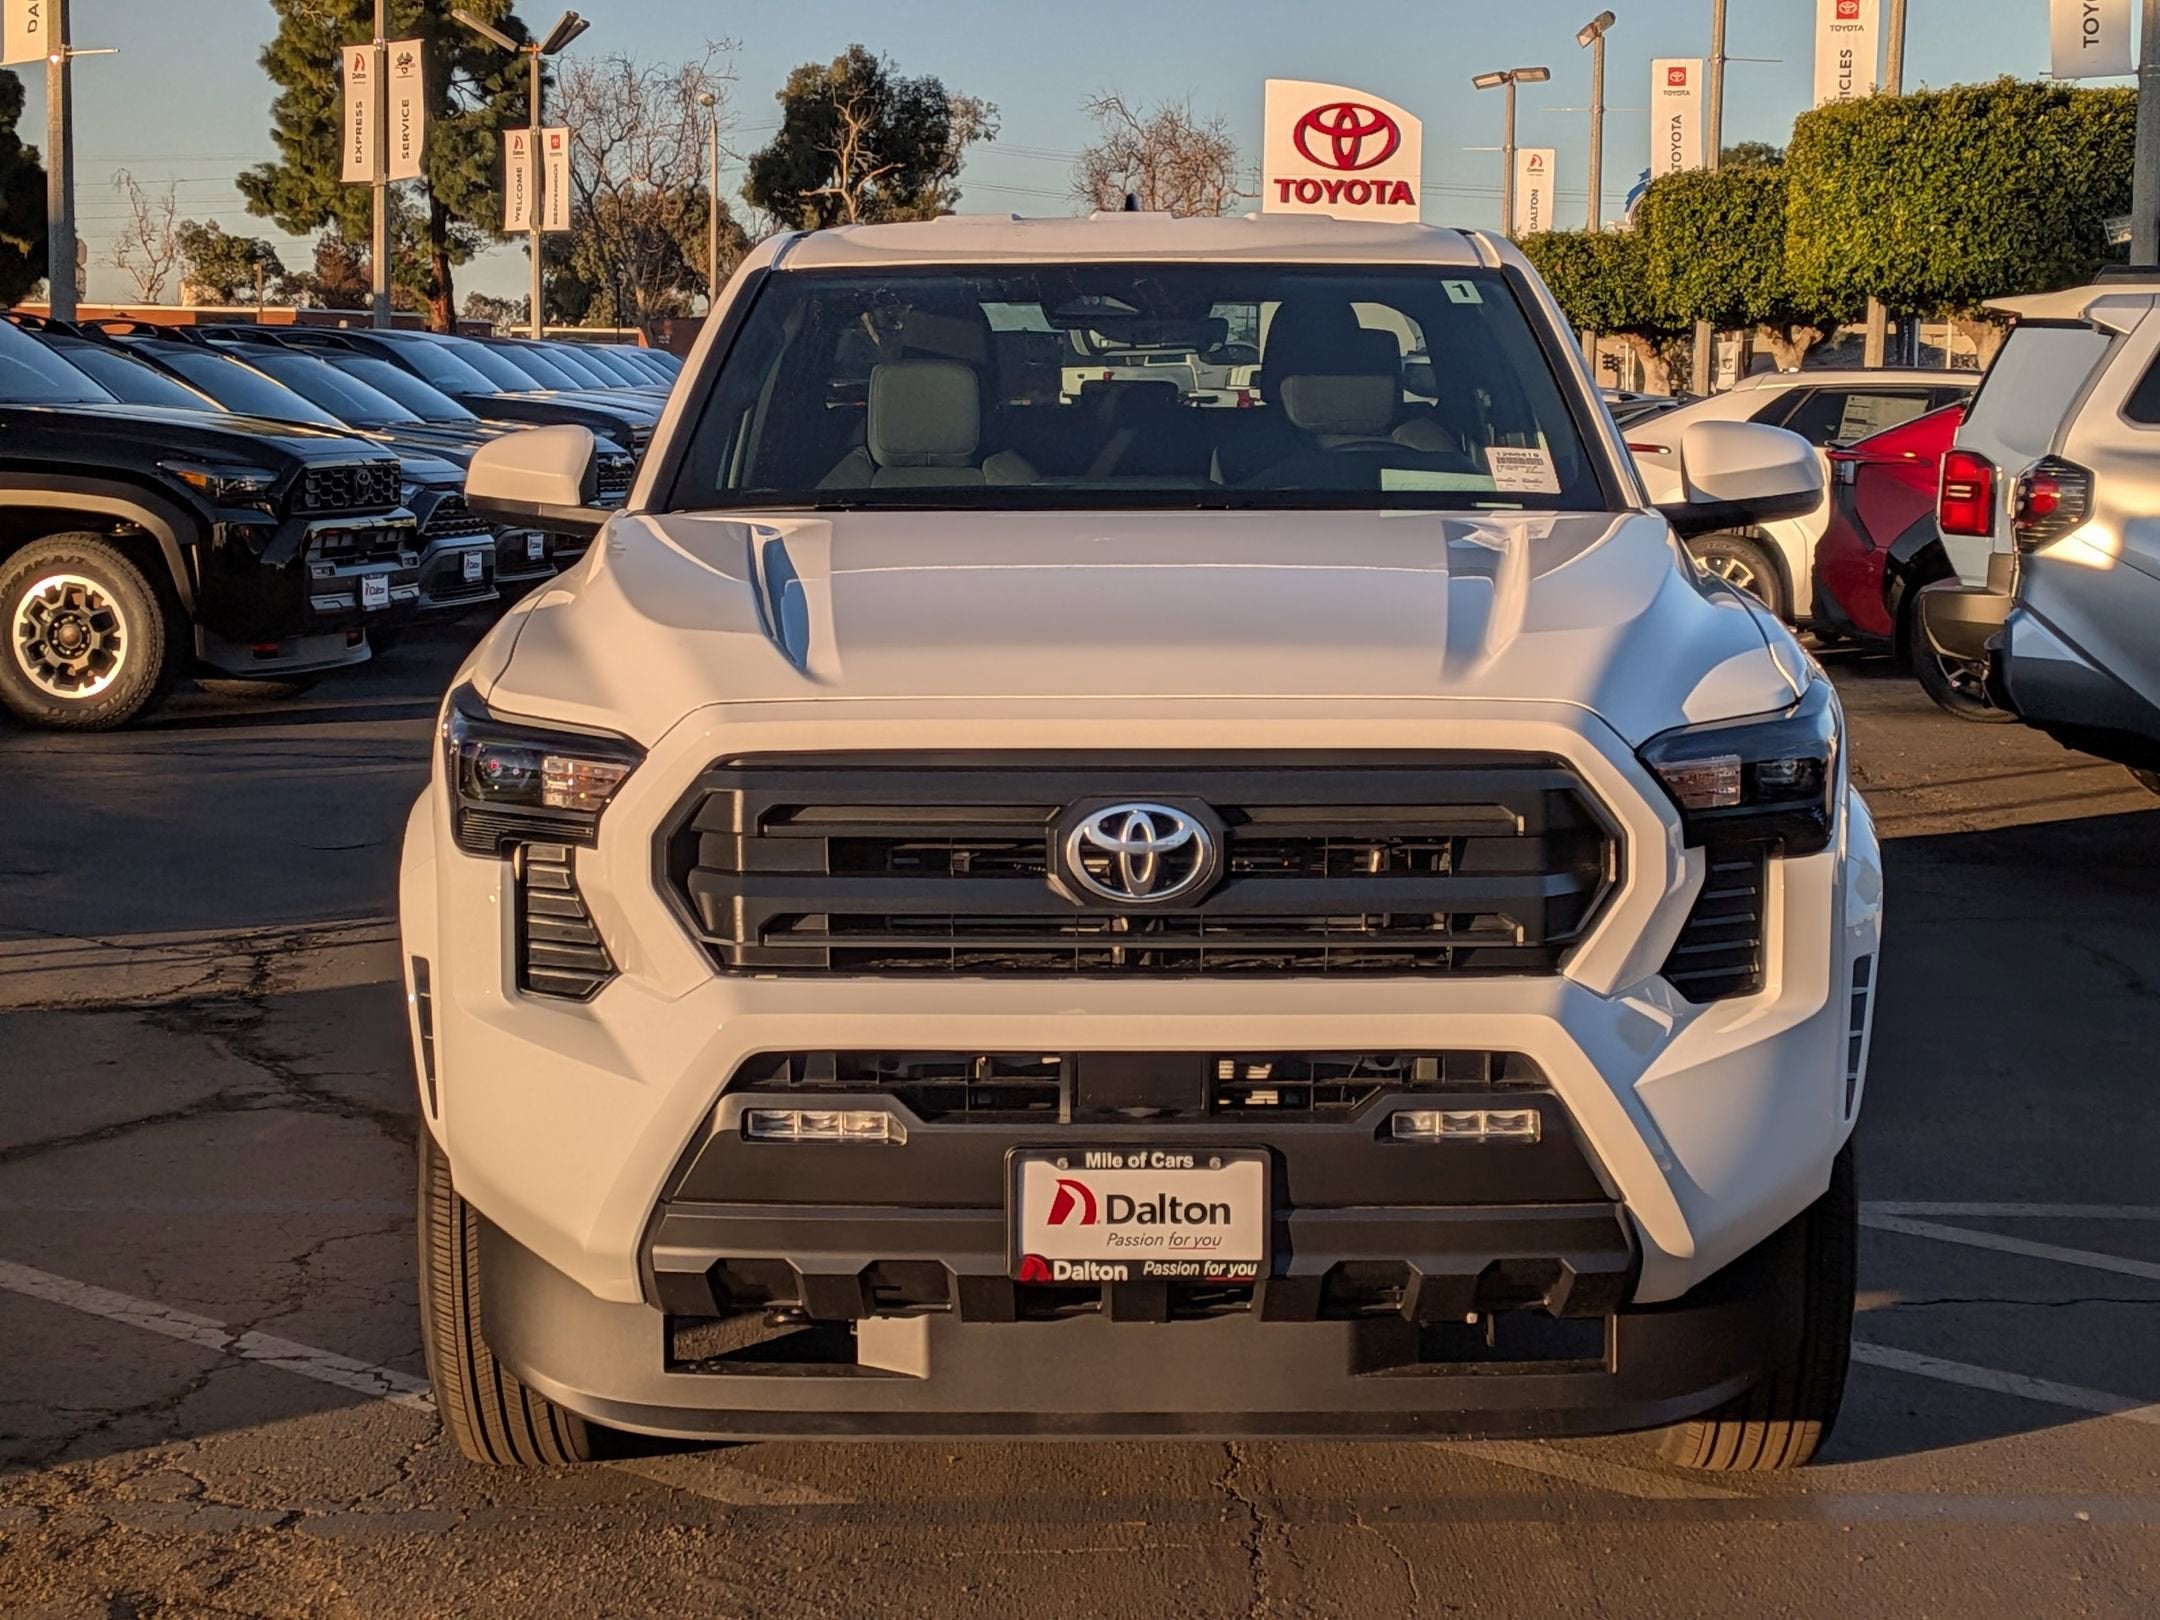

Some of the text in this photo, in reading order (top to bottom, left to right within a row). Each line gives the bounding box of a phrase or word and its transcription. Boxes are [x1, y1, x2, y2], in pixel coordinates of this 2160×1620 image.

[27, 0, 40, 34] DA
[1829, 24, 1864, 32] TOYOTA
[2083, 0, 2100, 49] TOY
[355, 101, 363, 164] EXPRESS
[401, 99, 410, 160] SERVICE
[514, 167, 523, 223] WELCOME
[1273, 178, 1416, 206] TOYOTA
[1530, 189, 1539, 230] DALTON
[1451, 283, 1471, 298] 1
[1085, 1152, 1194, 1169] Mile of Cars
[1105, 1193, 1232, 1226] Dalton
[1106, 1232, 1223, 1249] Passion for you
[1053, 1260, 1129, 1282] Dalton
[1142, 1260, 1258, 1279] Passion for you
